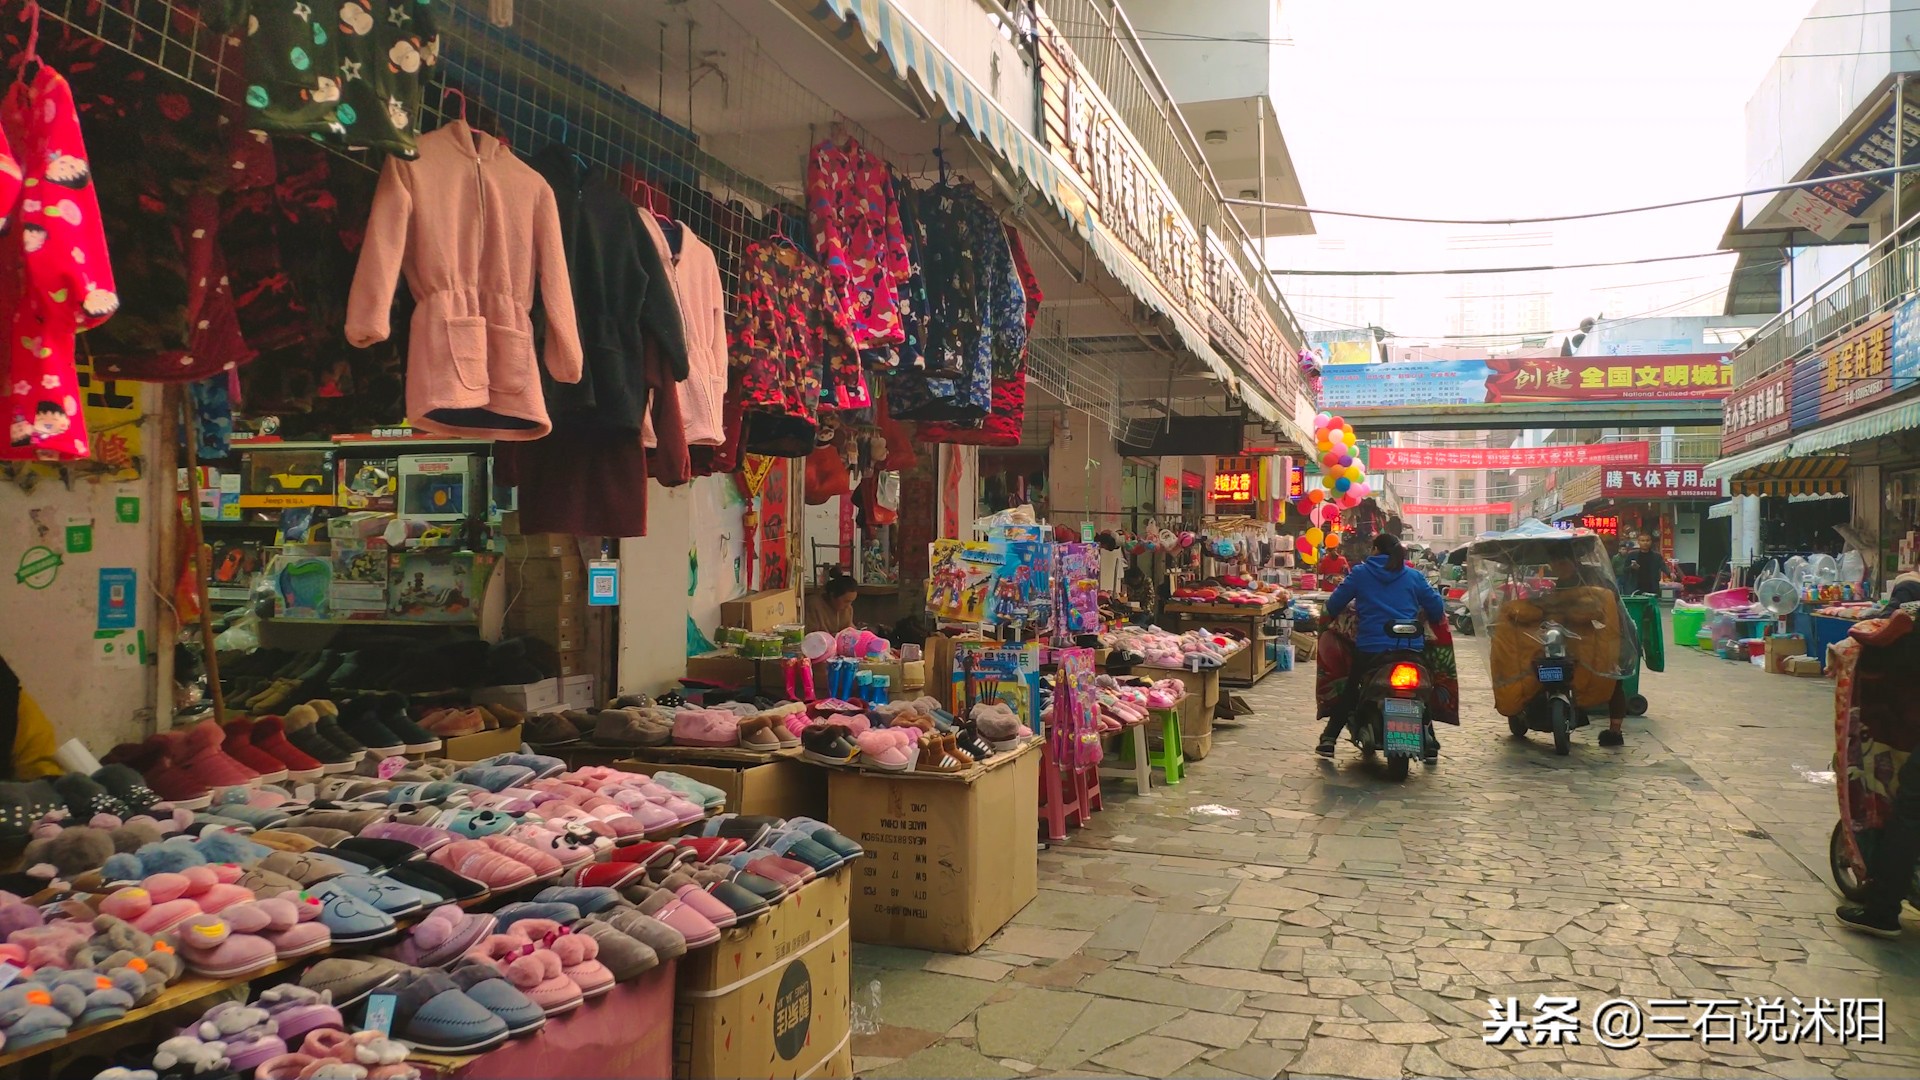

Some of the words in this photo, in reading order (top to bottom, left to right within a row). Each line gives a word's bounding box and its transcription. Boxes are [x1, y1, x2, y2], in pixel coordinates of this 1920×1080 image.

[1513, 366, 1573, 390] 创建
[1579, 364, 1734, 388] 全国文明城市
[1622, 390, 1655, 398] National
[1689, 389, 1707, 398] City
[1605, 469, 1717, 489] 腾飞体育用品
[880, 818, 899, 828] CHINA
[900, 819, 907, 829] IN
[908, 820, 927, 830] MADE
[892, 851, 899, 861] 12
[863, 867, 877, 876] KGS
[891, 869, 899, 879] 17
[863, 886, 877, 896] PCS
[890, 888, 900, 897] 48
[912, 908, 928, 919] ITEM
